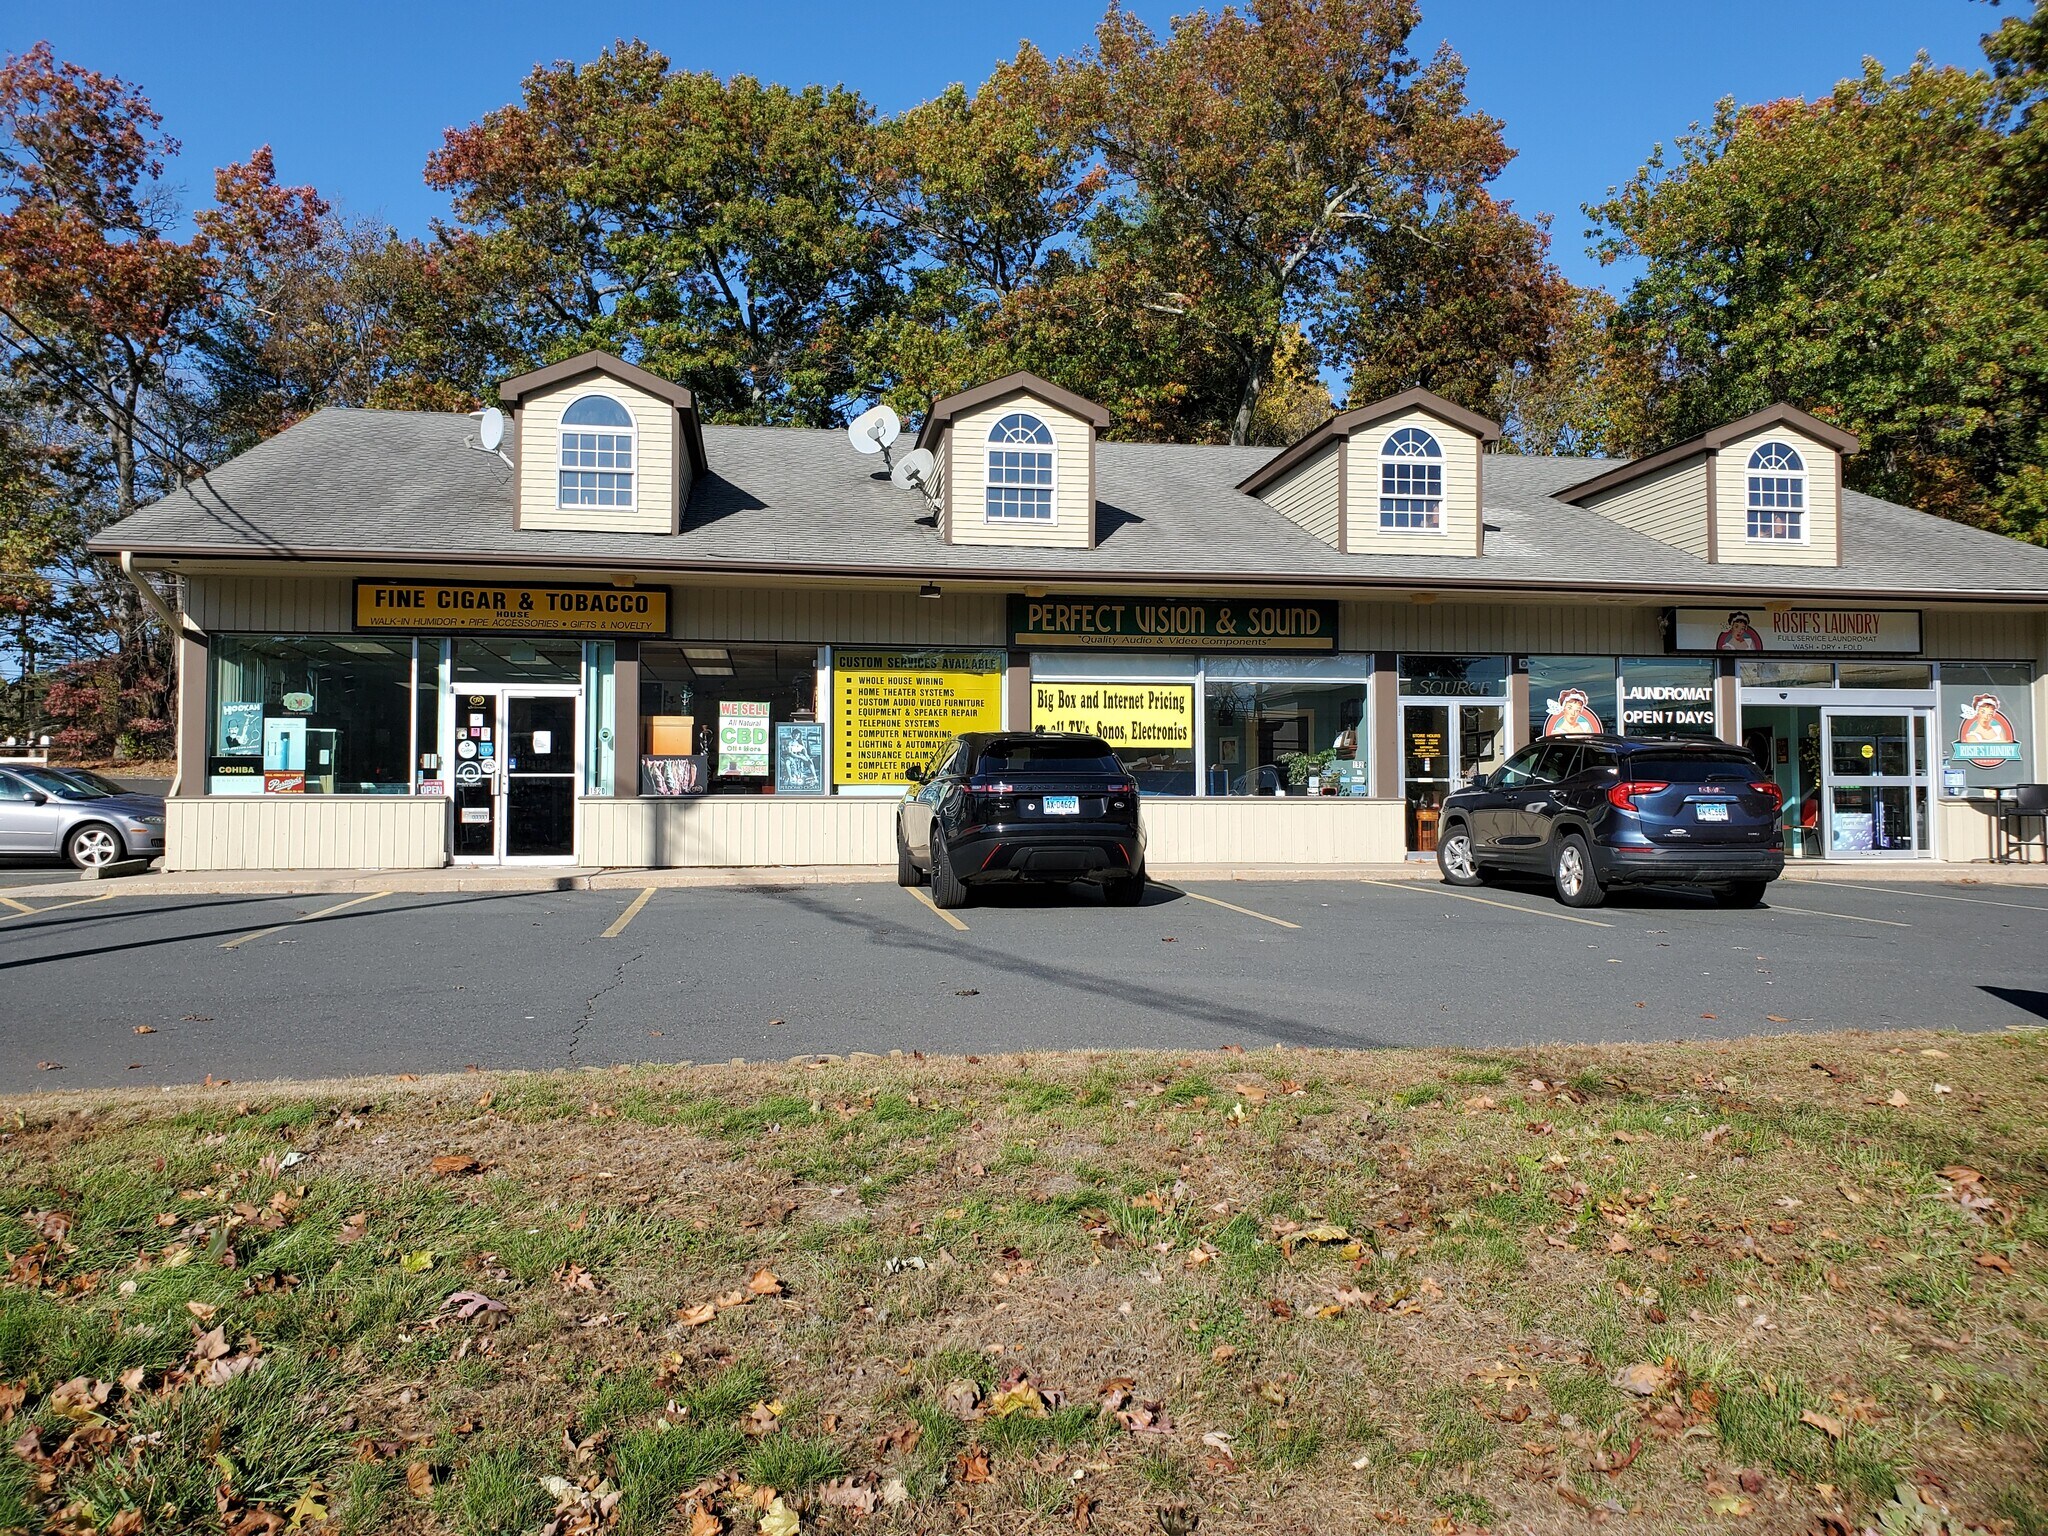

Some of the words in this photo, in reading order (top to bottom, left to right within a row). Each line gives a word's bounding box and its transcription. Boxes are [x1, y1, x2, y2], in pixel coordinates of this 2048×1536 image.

[375, 589, 425, 609] FINE
[437, 590, 506, 610] CIGAR
[519, 592, 534, 611] &
[546, 592, 649, 614] TOBACCO
[370, 617, 411, 626] WALK-IN
[413, 617, 457, 626] HUMIDOR
[468, 618, 490, 626] PIPE
[492, 619, 559, 628] ACCESSORIES
[570, 620, 597, 628] GIFTS
[600, 621, 607, 629] &
[610, 621, 653, 630] NOVELTY
[1028, 604, 1125, 632] PERFECT
[1135, 606, 1206, 634] VISION
[1215, 607, 1238, 634] &
[1247, 607, 1321, 635] SOUND
[1773, 612, 1821, 634] ROSIE'S
[1823, 613, 1881, 635] LAUNDRY
[1121, 636, 1154, 645] Audio
[1156, 637, 1165, 645] &
[1168, 636, 1199, 646] Video
[1777, 634, 1796, 642] FULL
[1828, 635, 1877, 643] LAUNDROMAT
[1821, 643, 1836, 651] DRY
[1843, 643, 1863, 651] FOLD
[839, 656, 883, 668] CUSTOM
[887, 657, 937, 669] SERVICES
[858, 676, 884, 685] WHOLE
[887, 677, 913, 685] HOUSE
[916, 677, 944, 686] WIRING
[858, 688, 880, 696] HOME
[883, 688, 917, 697] THEATER
[919, 689, 955, 697] SYSTEMS
[1418, 680, 1493, 696] SOURCE
[1622, 686, 1713, 701] LAUNDROMAT
[858, 698, 890, 706] CUSTOM
[944, 699, 985, 708] FURNITURE
[1037, 689, 1054, 712] Big
[1058, 689, 1077, 709] Box
[1080, 690, 1099, 709] and
[1103, 690, 1144, 710] Internet
[1148, 691, 1186, 714] Pricing
[223, 704, 261, 715] HOOKAH
[721, 703, 738, 715] WE
[742, 703, 768, 716] SELL
[858, 708, 901, 717] EQUIPMENT
[914, 709, 948, 717] SPEAKER
[951, 709, 978, 717] REPAIR
[1622, 710, 1663, 724] OPEN
[1666, 711, 1674, 724] 7
[1675, 711, 1714, 724] DAYS
[739, 719, 762, 727] Natural
[858, 719, 901, 728] TELEPHONE
[904, 720, 940, 728] SYSTEMS
[720, 727, 768, 745] CBD
[858, 730, 900, 738] COMPUTER
[902, 731, 952, 739] NETWORKING
[1096, 720, 1128, 744] Sonos,
[1132, 721, 1187, 741] Electronics
[858, 740, 893, 749] LIGHTING
[896, 740, 902, 749] &
[858, 750, 902, 759] INSURANCE
[905, 751, 935, 760] CLAIMS
[1986, 745, 2015, 757] LAUNDRY
[218, 766, 255, 774] COHIBA
[858, 761, 898, 770] COMPLETE
[858, 772, 879, 780] SHOP
[882, 772, 892, 780] AT
[420, 785, 443, 795] OPEN
